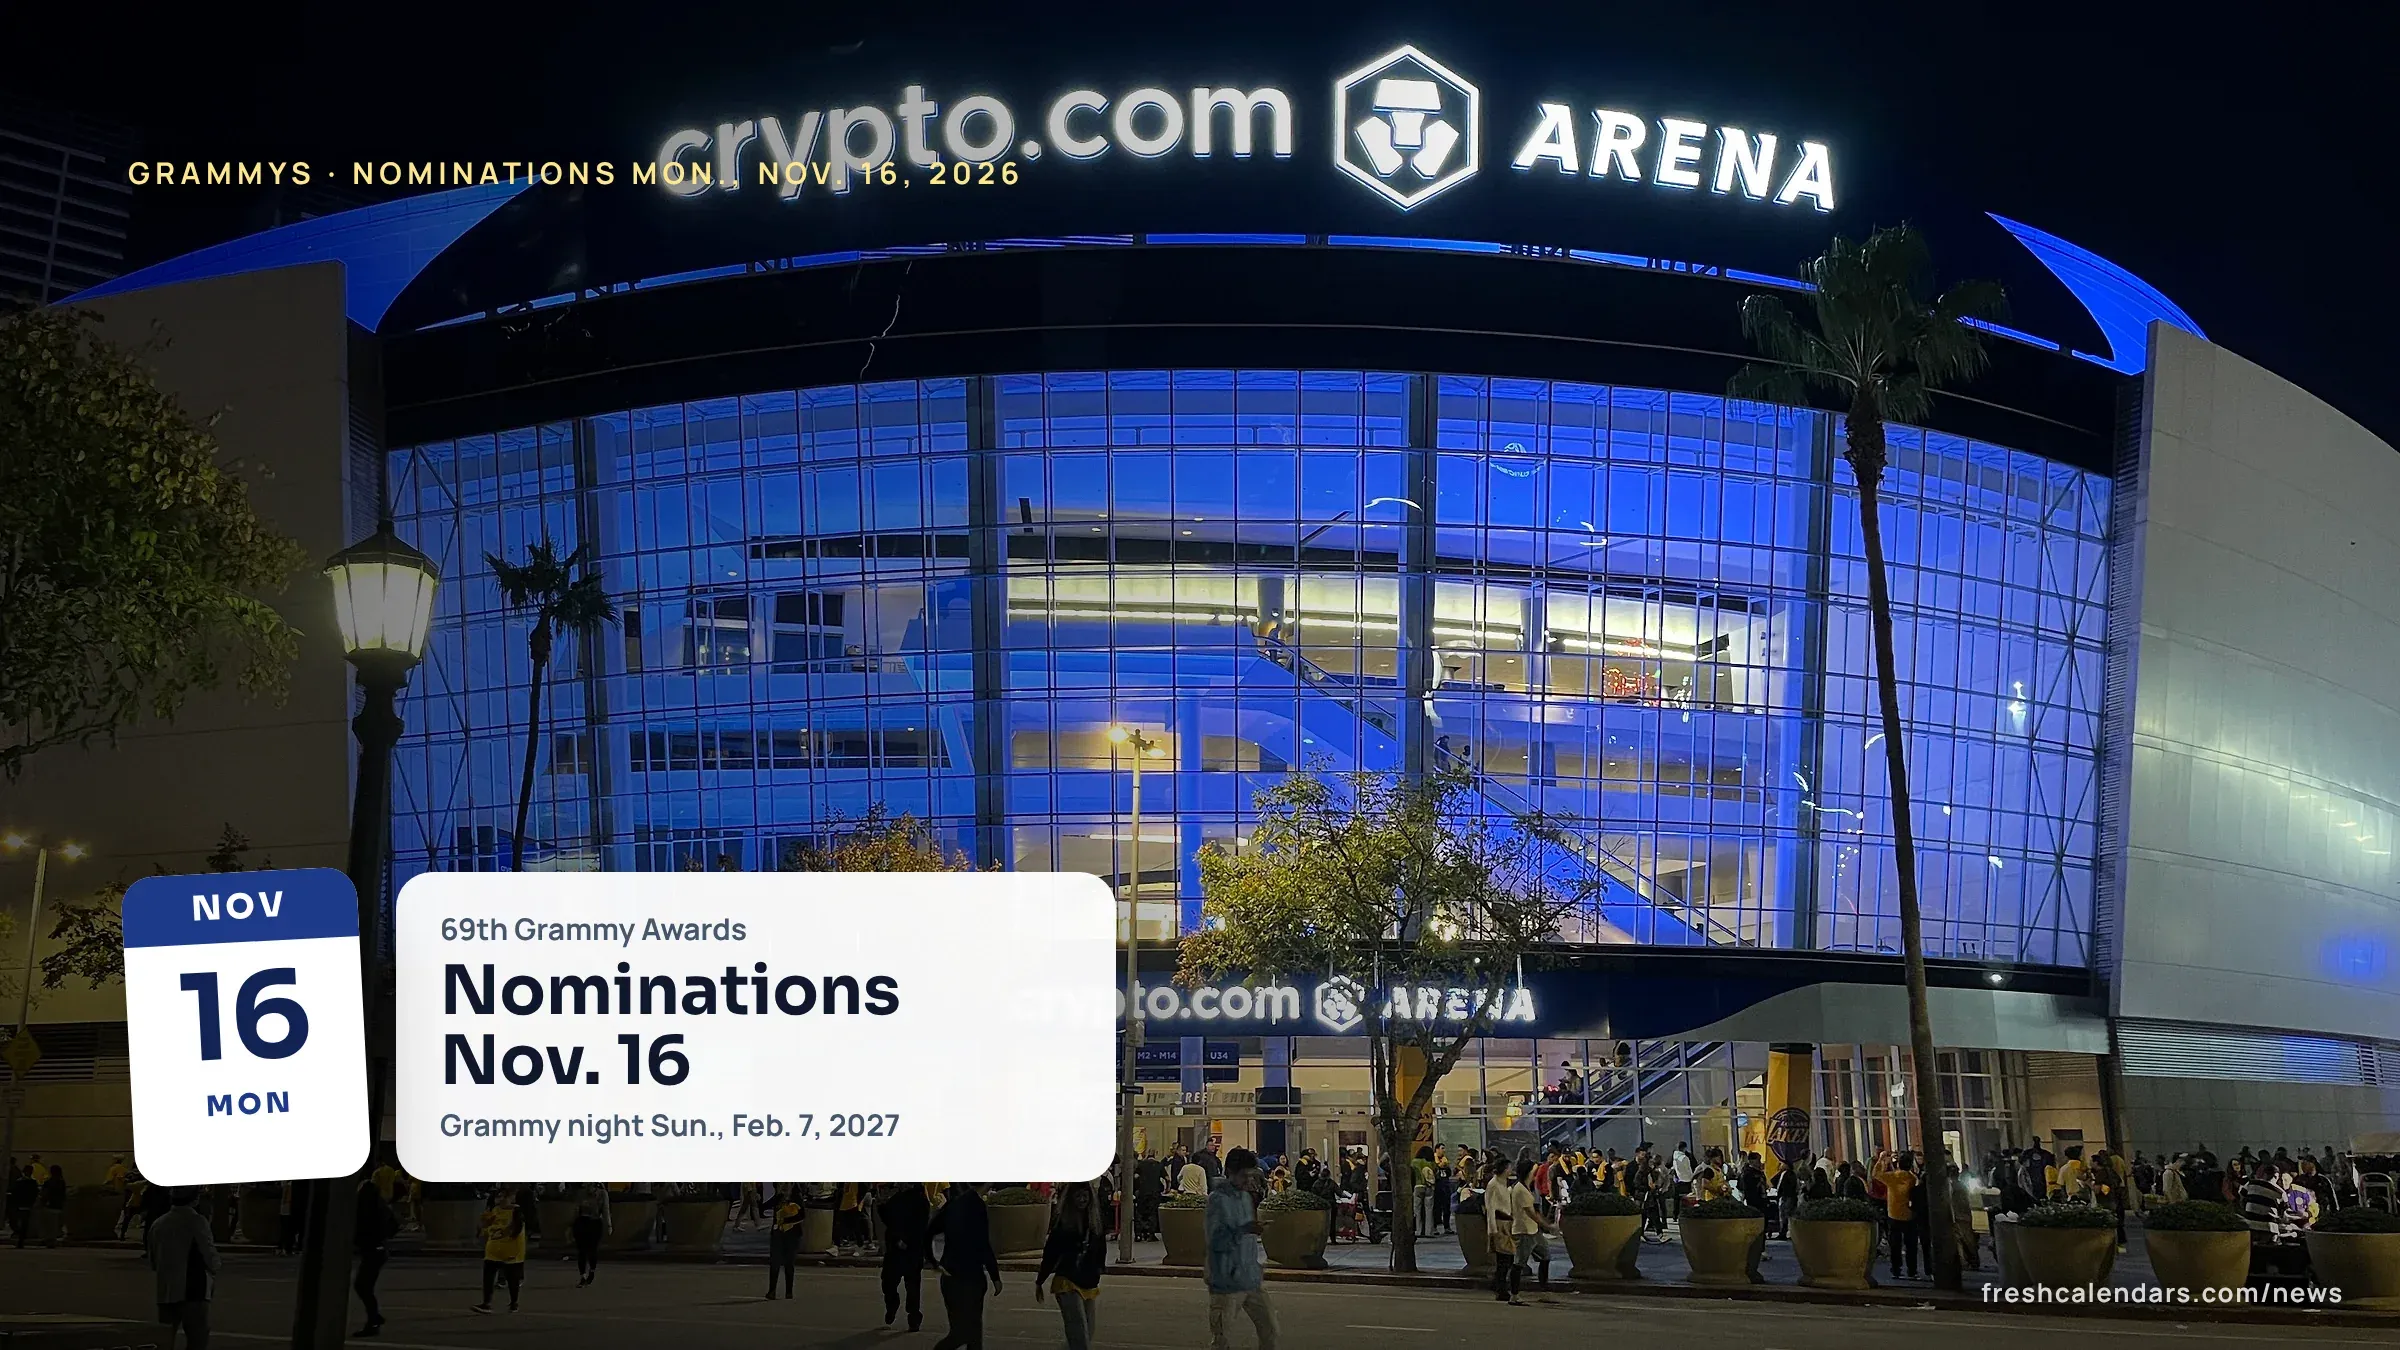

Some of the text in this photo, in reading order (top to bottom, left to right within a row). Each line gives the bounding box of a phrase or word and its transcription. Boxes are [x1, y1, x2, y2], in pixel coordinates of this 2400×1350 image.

[658, 85, 1836, 213] crypto.com ARENA
[1116, 979, 1300, 1020] to.com
[1137, 1052, 1151, 1060] M2
[1159, 1052, 1177, 1060] M14
[1210, 1052, 1228, 1060] U34
